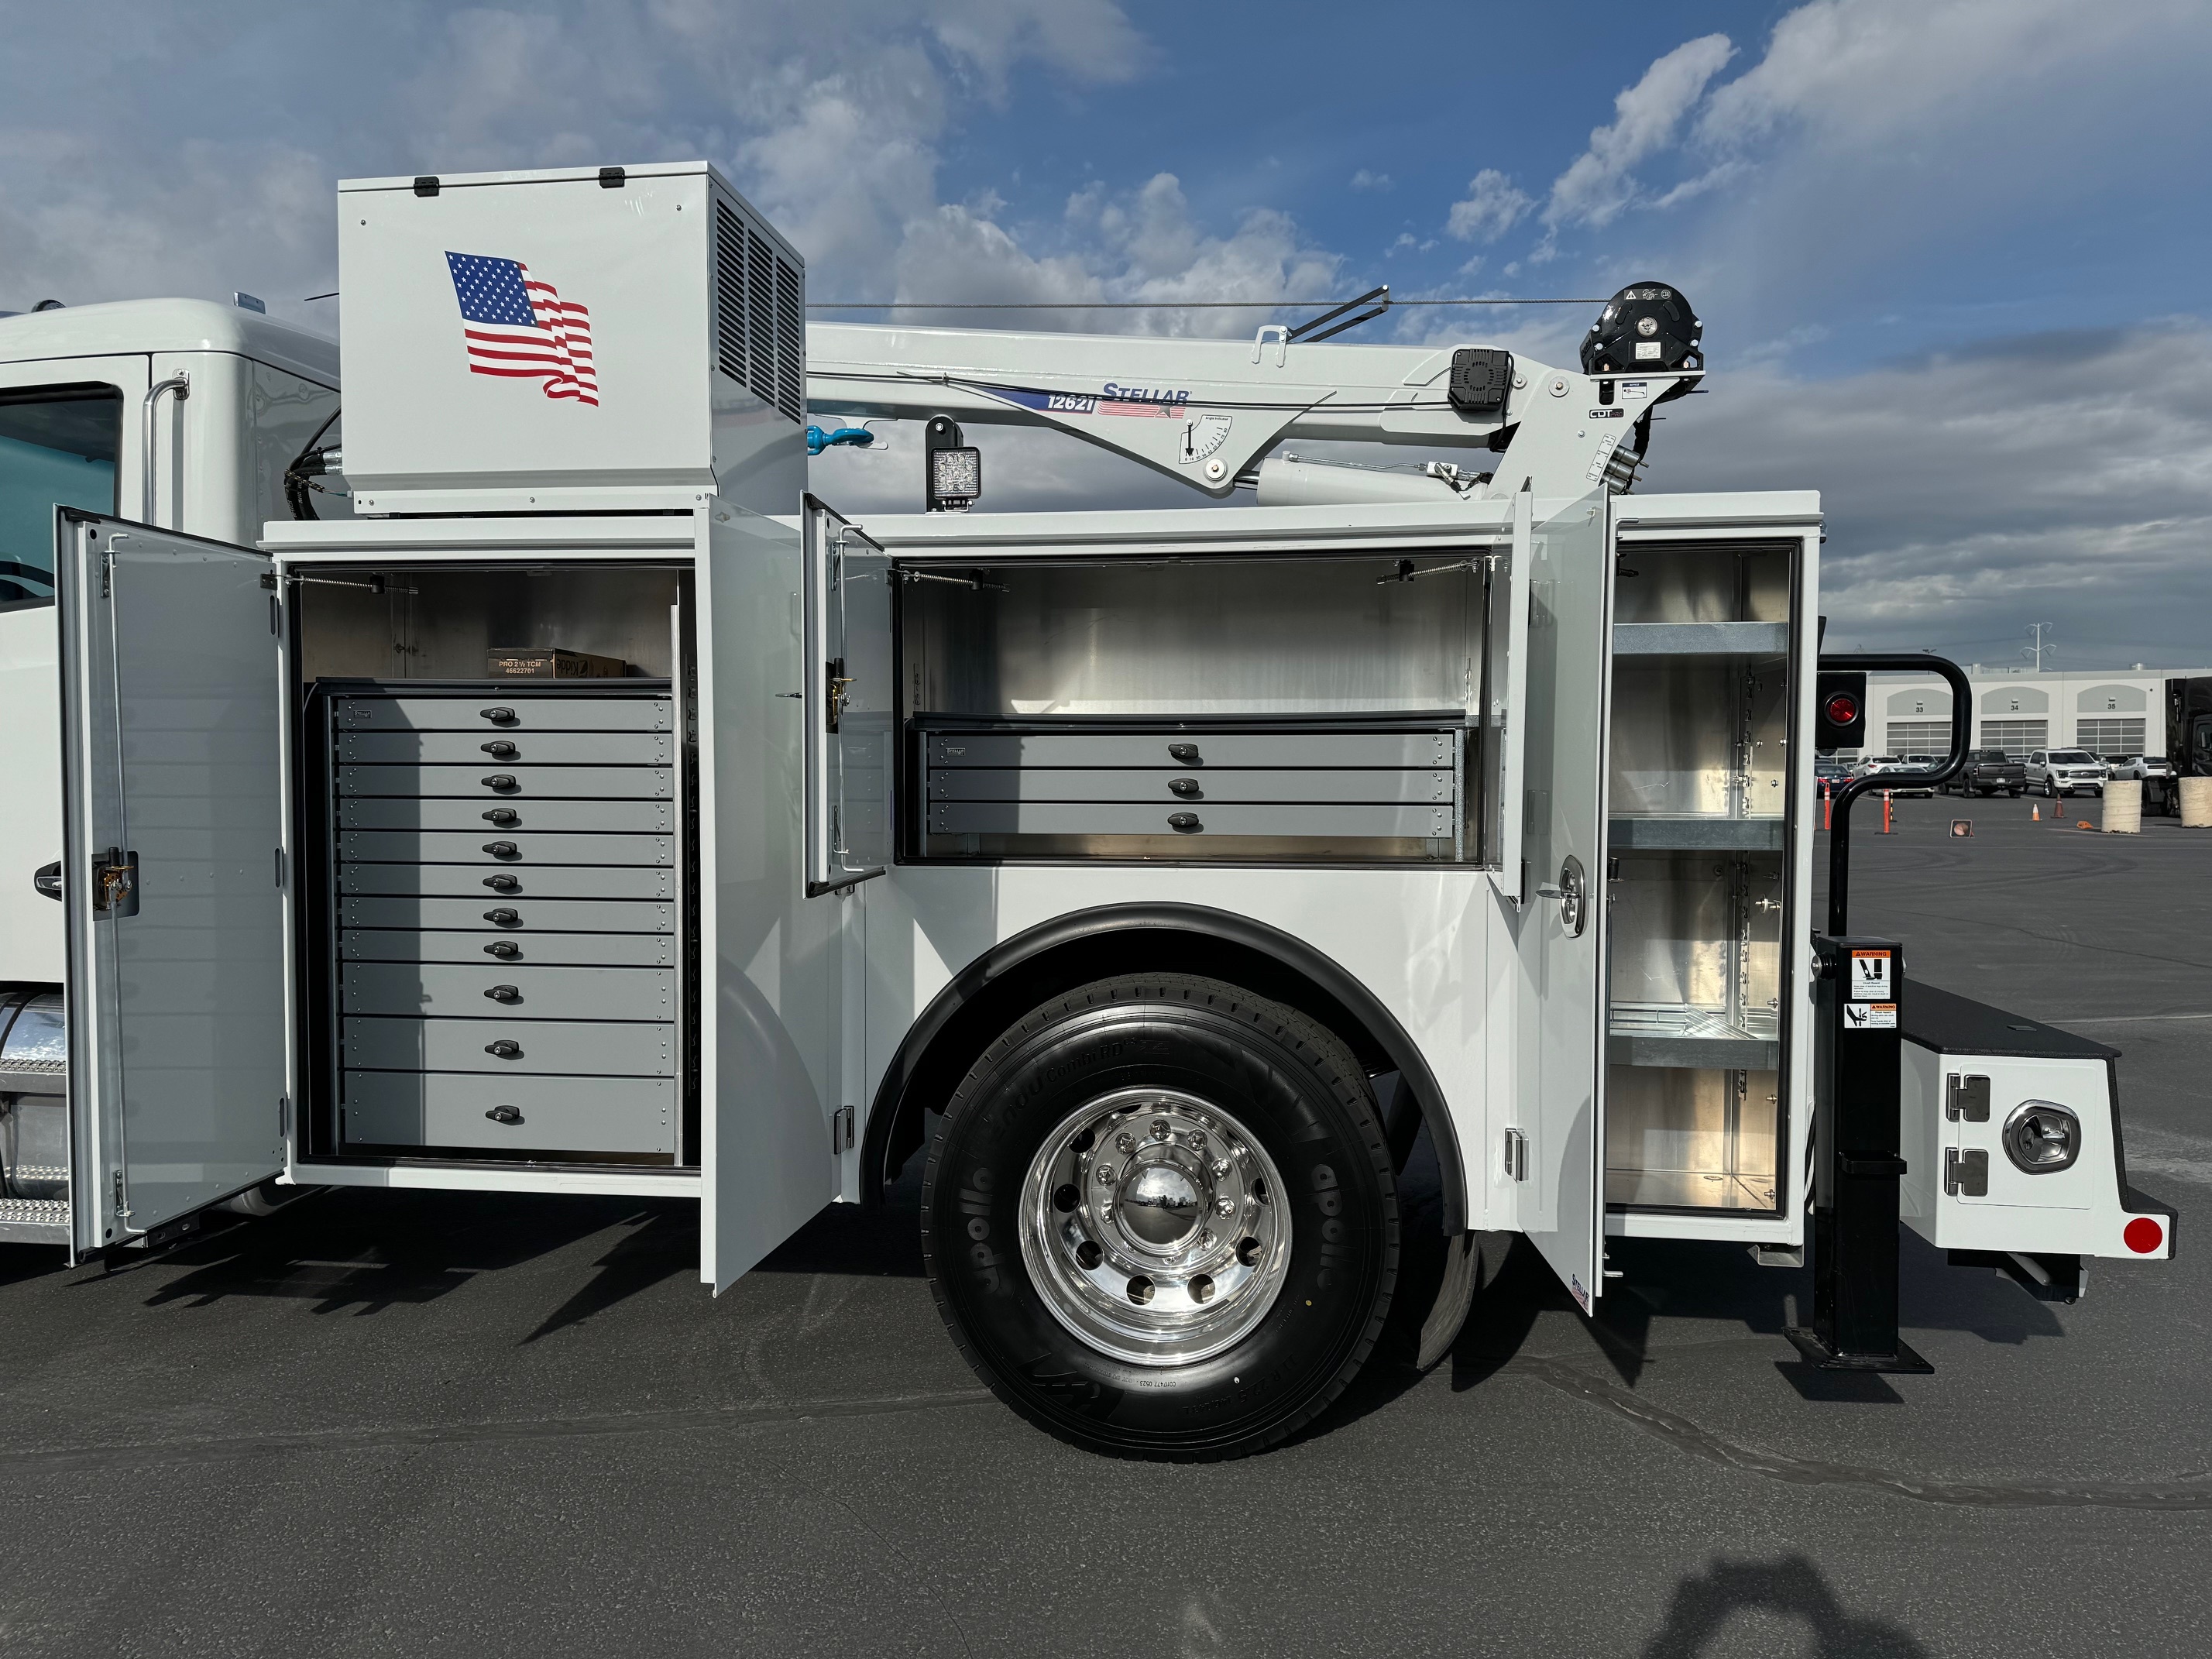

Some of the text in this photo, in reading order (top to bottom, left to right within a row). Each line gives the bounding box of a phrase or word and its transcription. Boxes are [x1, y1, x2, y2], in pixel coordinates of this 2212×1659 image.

[1048, 394, 1094, 411] 12621
[1101, 382, 1190, 405] STELLAR
[556, 658, 579, 676] Kidde
[959, 1167, 1005, 1295] apollo
[1306, 1163, 1357, 1294] apollo
